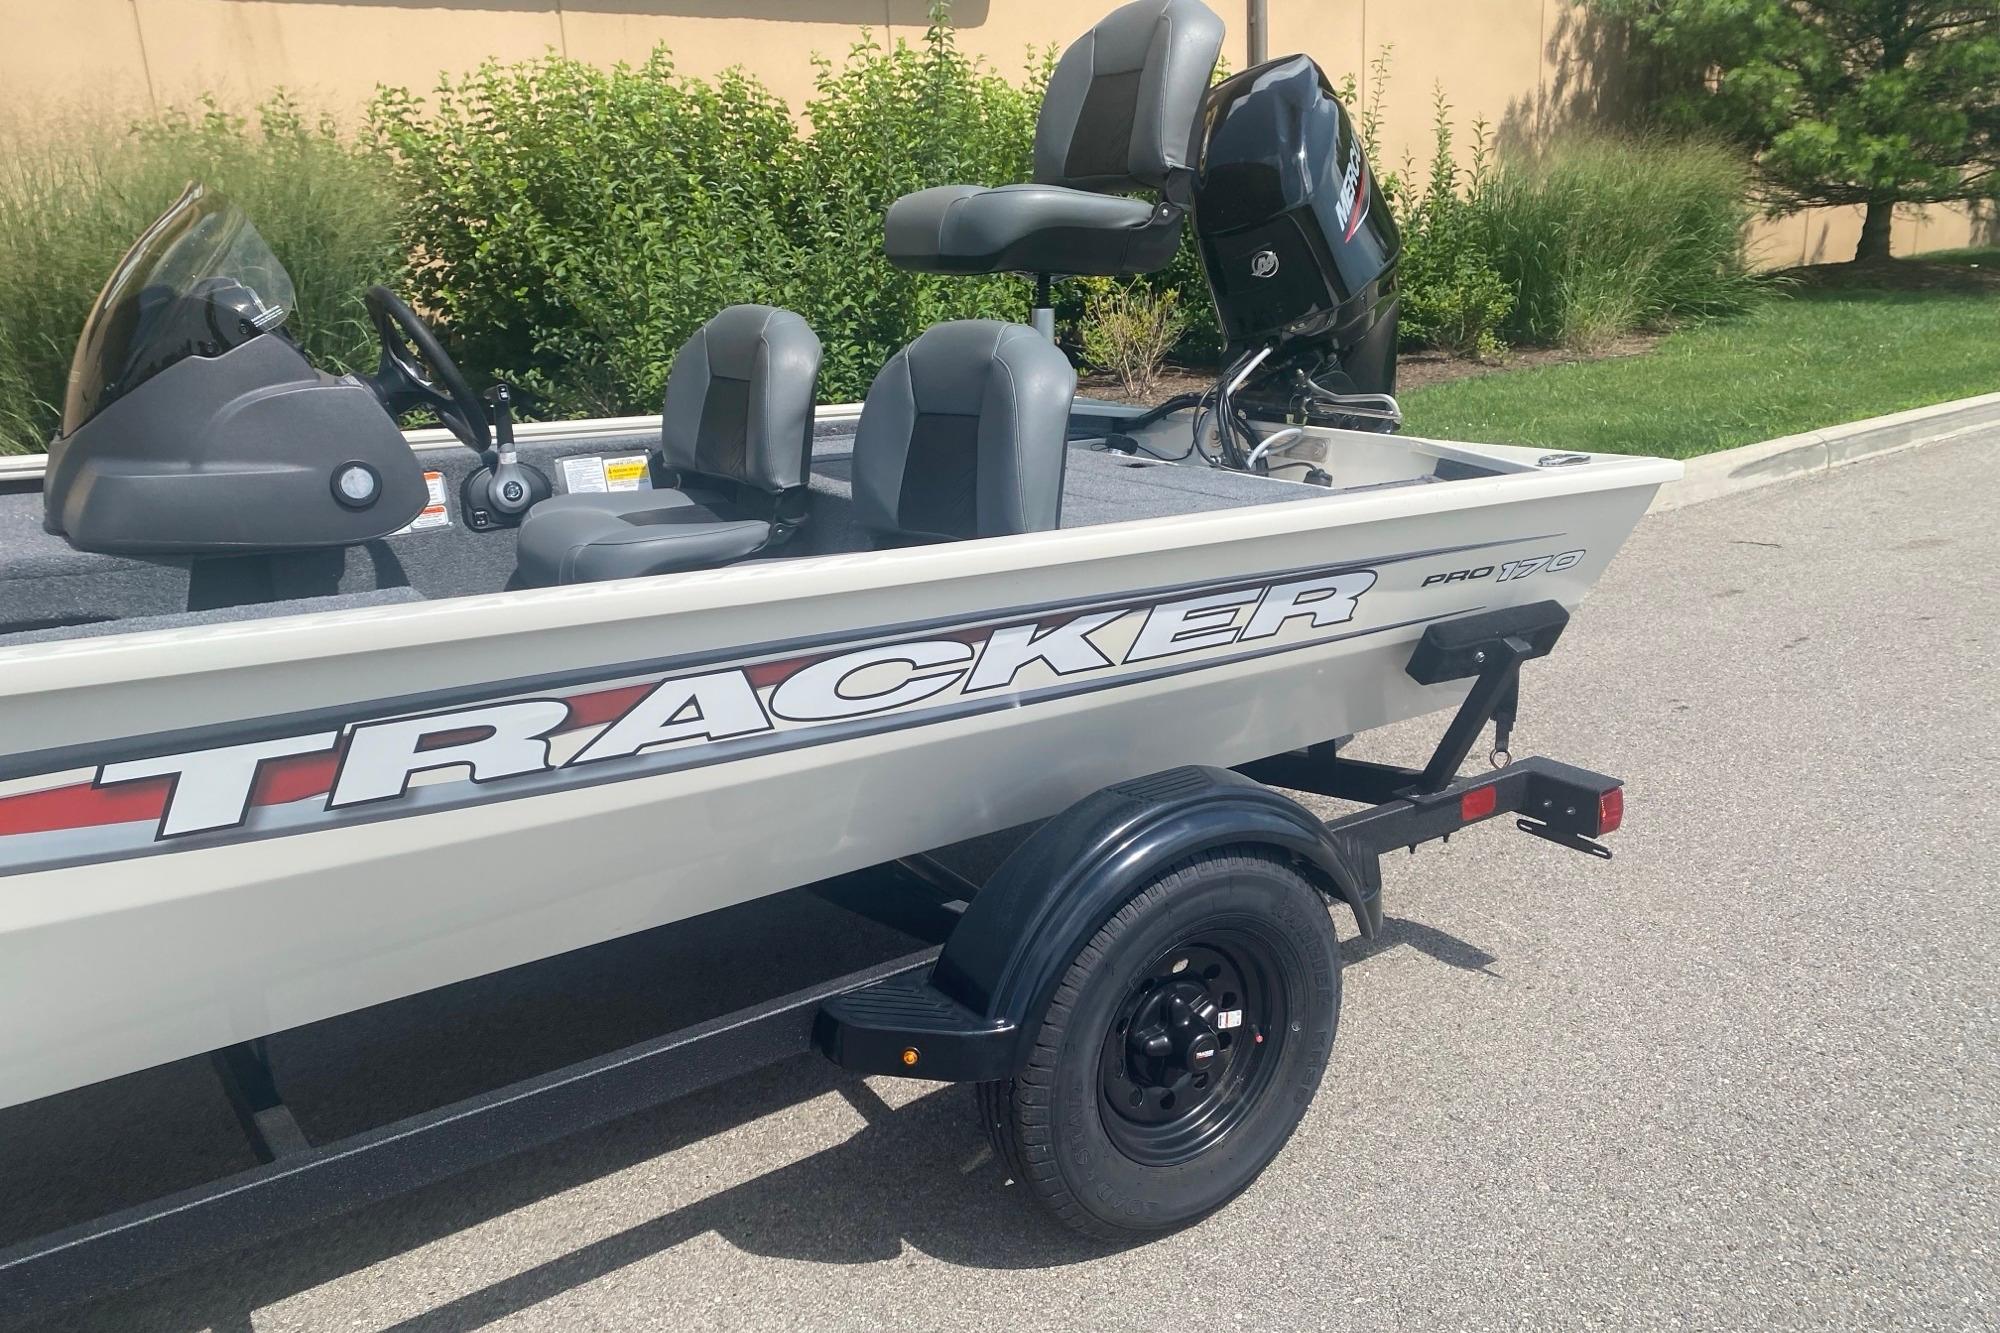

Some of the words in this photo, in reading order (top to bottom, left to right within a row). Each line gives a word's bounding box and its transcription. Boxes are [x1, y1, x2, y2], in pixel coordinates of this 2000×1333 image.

[1335, 139, 1361, 232] MERCU
[1421, 566, 1495, 587] PRO
[1496, 549, 1586, 583] 170
[93, 569, 1377, 842] TRACKER
